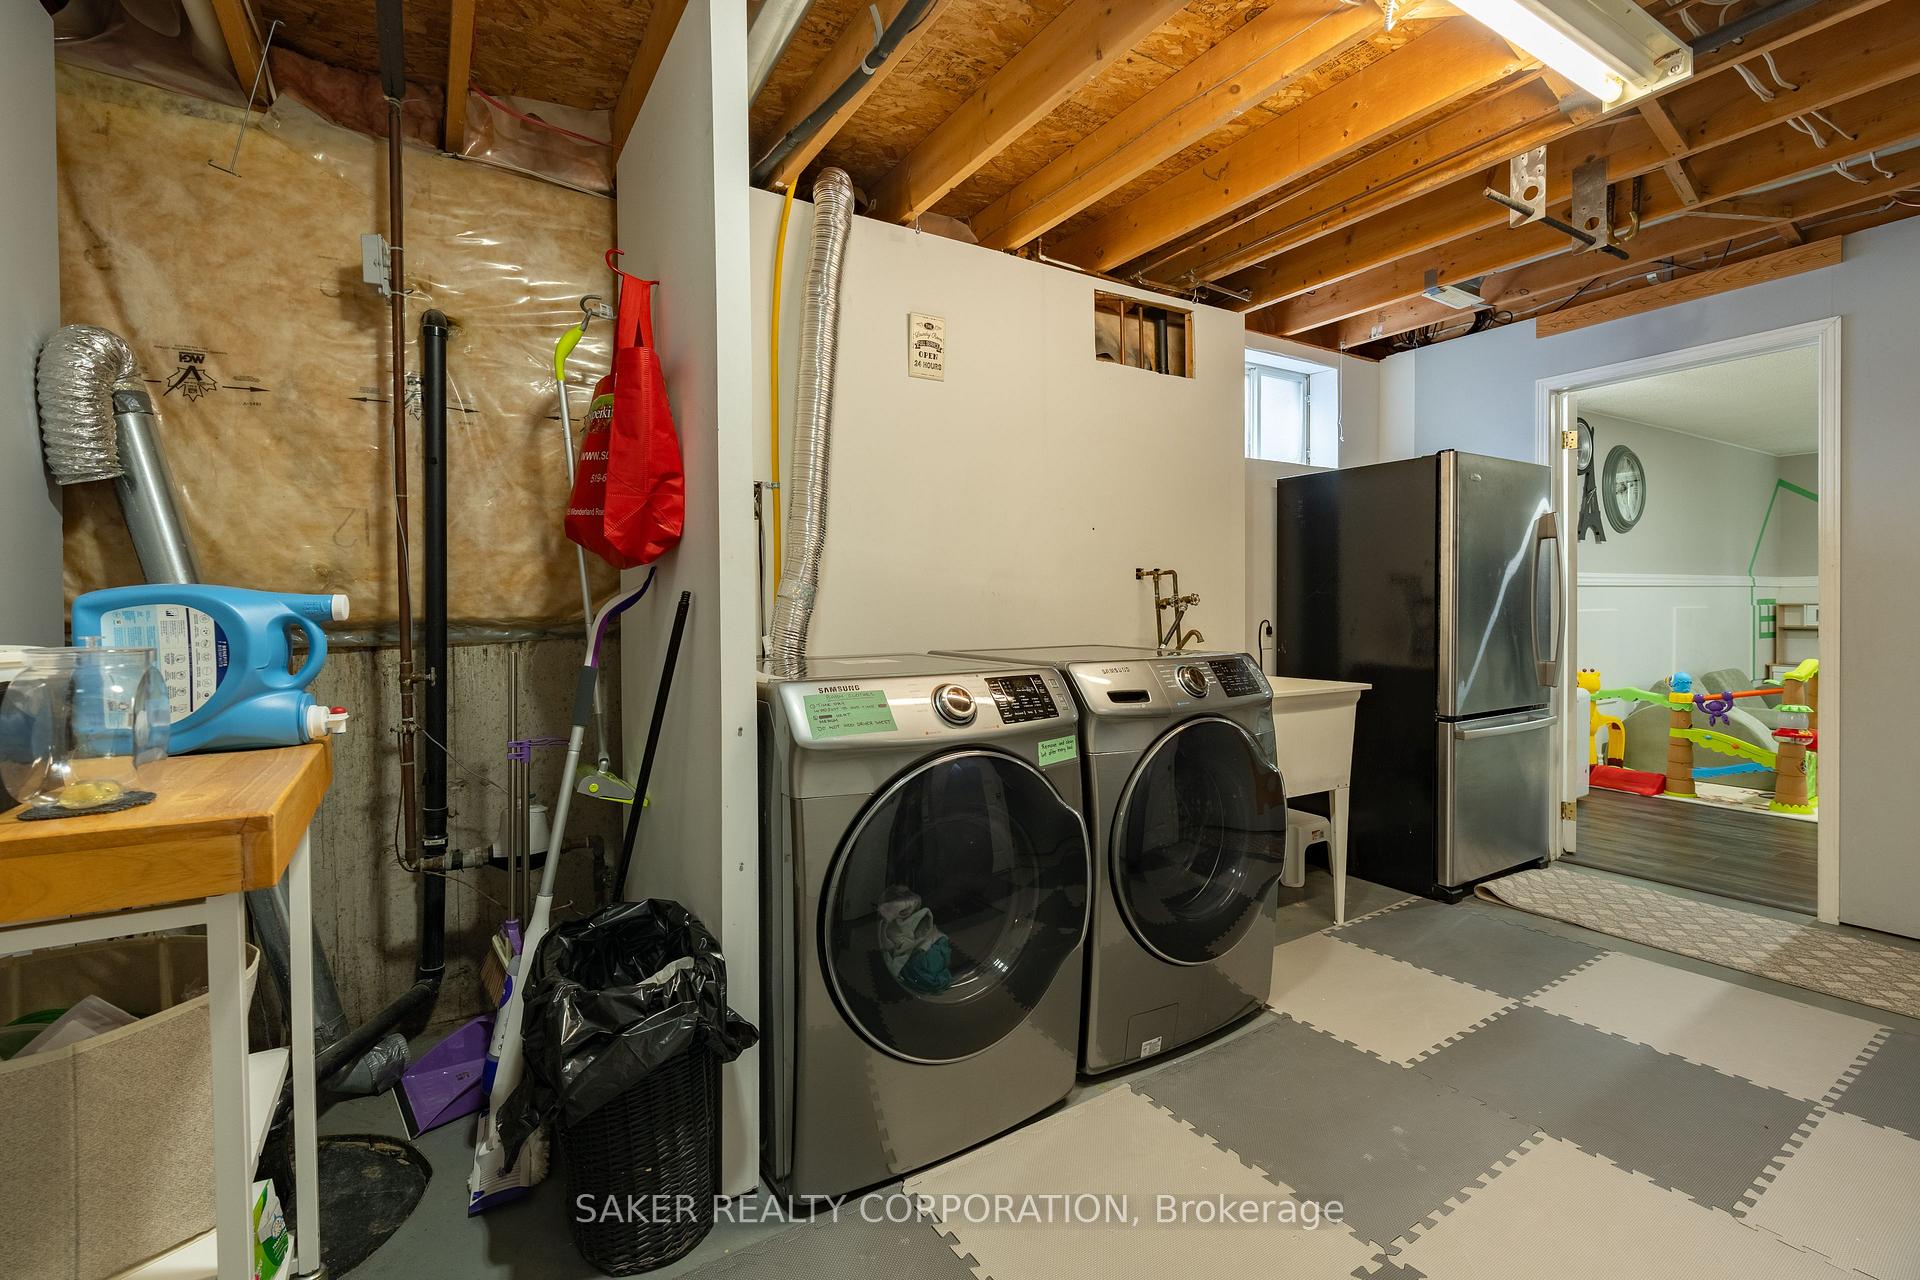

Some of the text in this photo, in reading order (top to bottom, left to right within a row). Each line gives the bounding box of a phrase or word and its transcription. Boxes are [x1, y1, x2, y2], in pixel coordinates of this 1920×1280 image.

[918, 351, 938, 360] OPEN
[923, 361, 942, 370] HOURS
[818, 684, 860, 694] SAMSUNG
